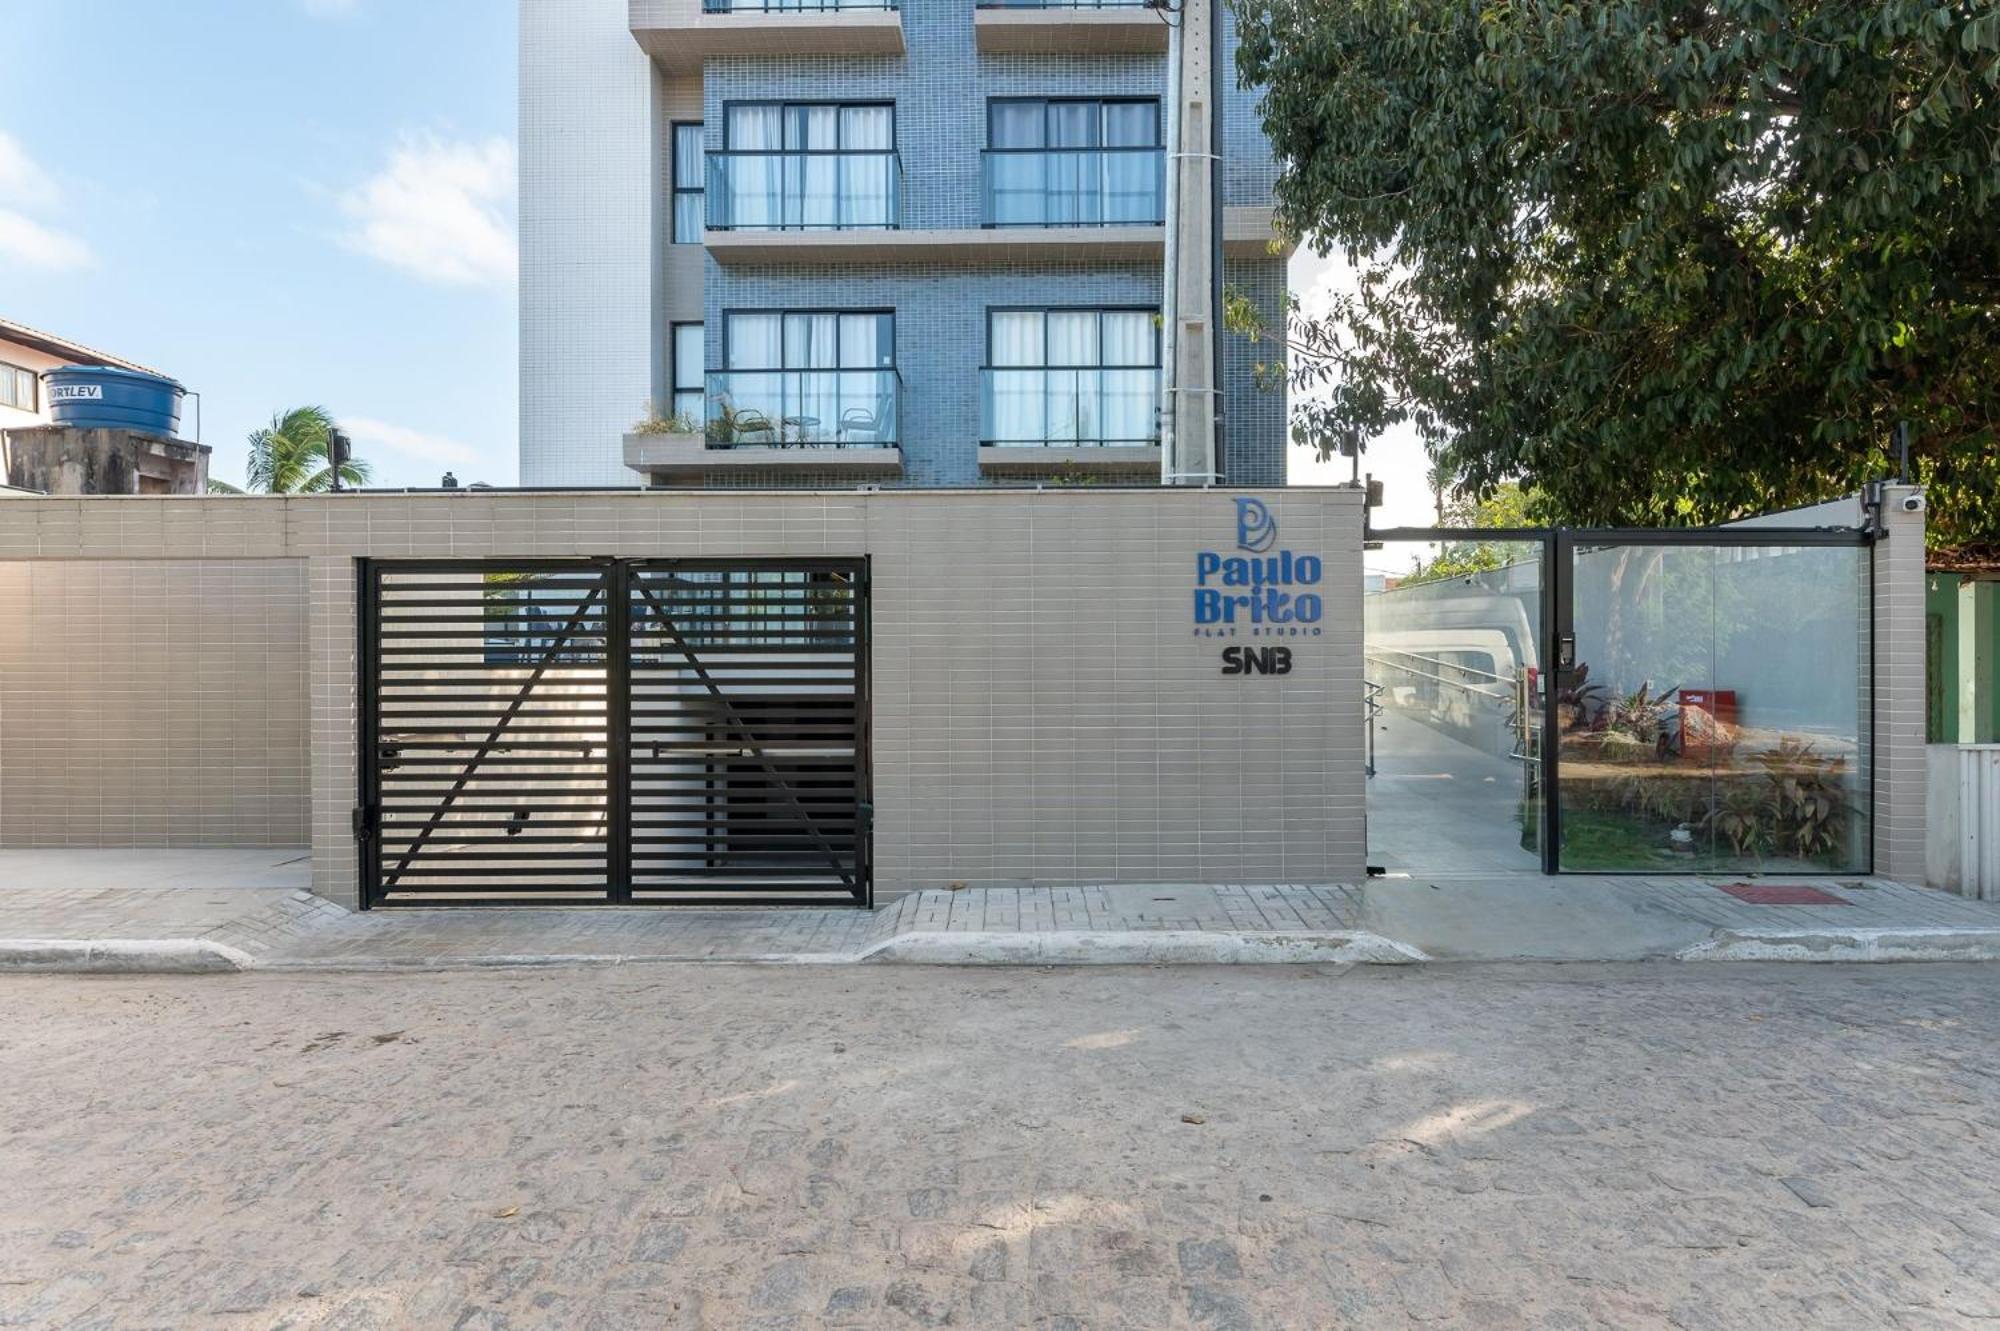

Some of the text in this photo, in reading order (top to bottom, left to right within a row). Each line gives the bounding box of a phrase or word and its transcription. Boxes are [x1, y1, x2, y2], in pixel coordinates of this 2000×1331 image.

[50, 386, 97, 398] ORTLEV
[1197, 550, 1322, 586] Paulo
[1194, 586, 1322, 624] Brito
[1194, 627, 1321, 637] FLAT STUDIO
[1221, 646, 1292, 675] SNB
